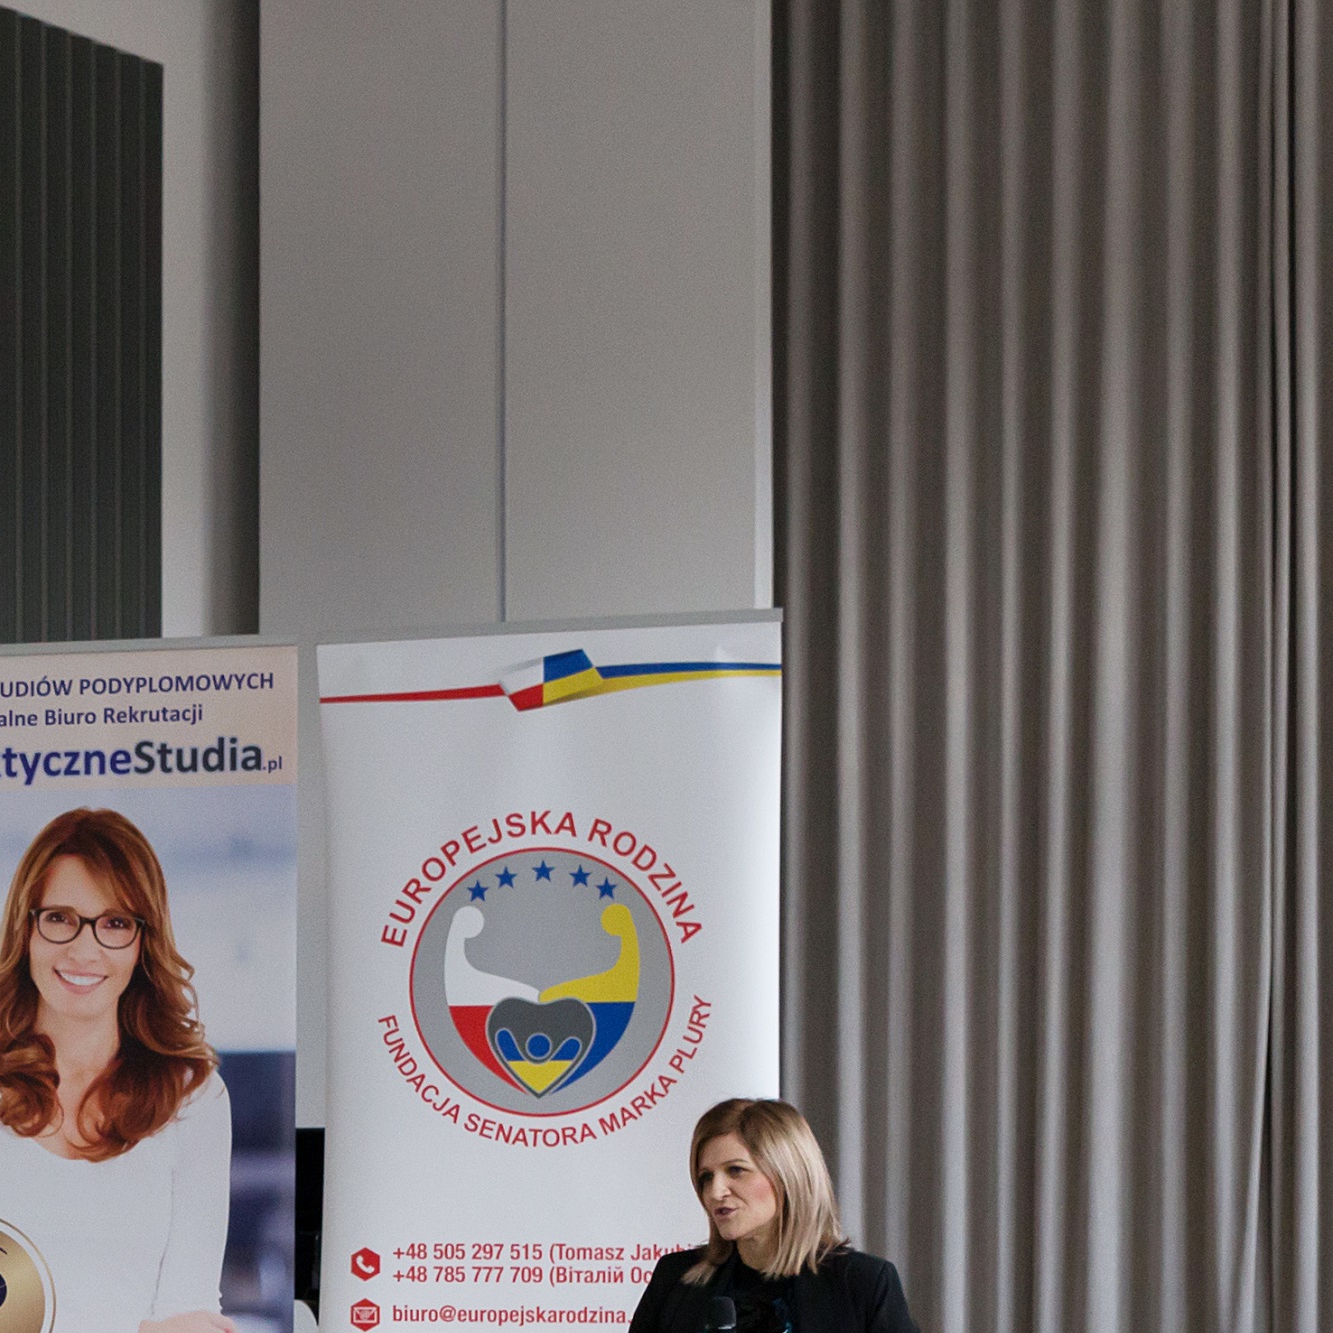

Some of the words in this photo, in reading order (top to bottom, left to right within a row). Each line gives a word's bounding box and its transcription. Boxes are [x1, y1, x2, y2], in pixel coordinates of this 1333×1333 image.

[80, 673, 273, 695] PODYPLOMOWYCH
[45, 709, 96, 725] Biuro
[104, 704, 202, 725] Rekrutacji
[380, 810, 577, 948] EUROPEJSKA
[588, 818, 703, 945] RODZINA
[377, 1013, 460, 1124] FUNDACJA
[464, 1114, 597, 1147] SENATORA
[599, 1076, 677, 1136] MARKA
[671, 994, 712, 1074] PLURY
[393, 1243, 427, 1259] +48
[434, 1243, 465, 1259] 505
[472, 1244, 504, 1260] 297
[511, 1244, 542, 1260] 515
[550, 1243, 624, 1263] (Tomasz
[394, 1266, 427, 1282] +48
[434, 1266, 465, 1282] 785
[472, 1266, 503, 1282] 777
[510, 1267, 543, 1283] 709
